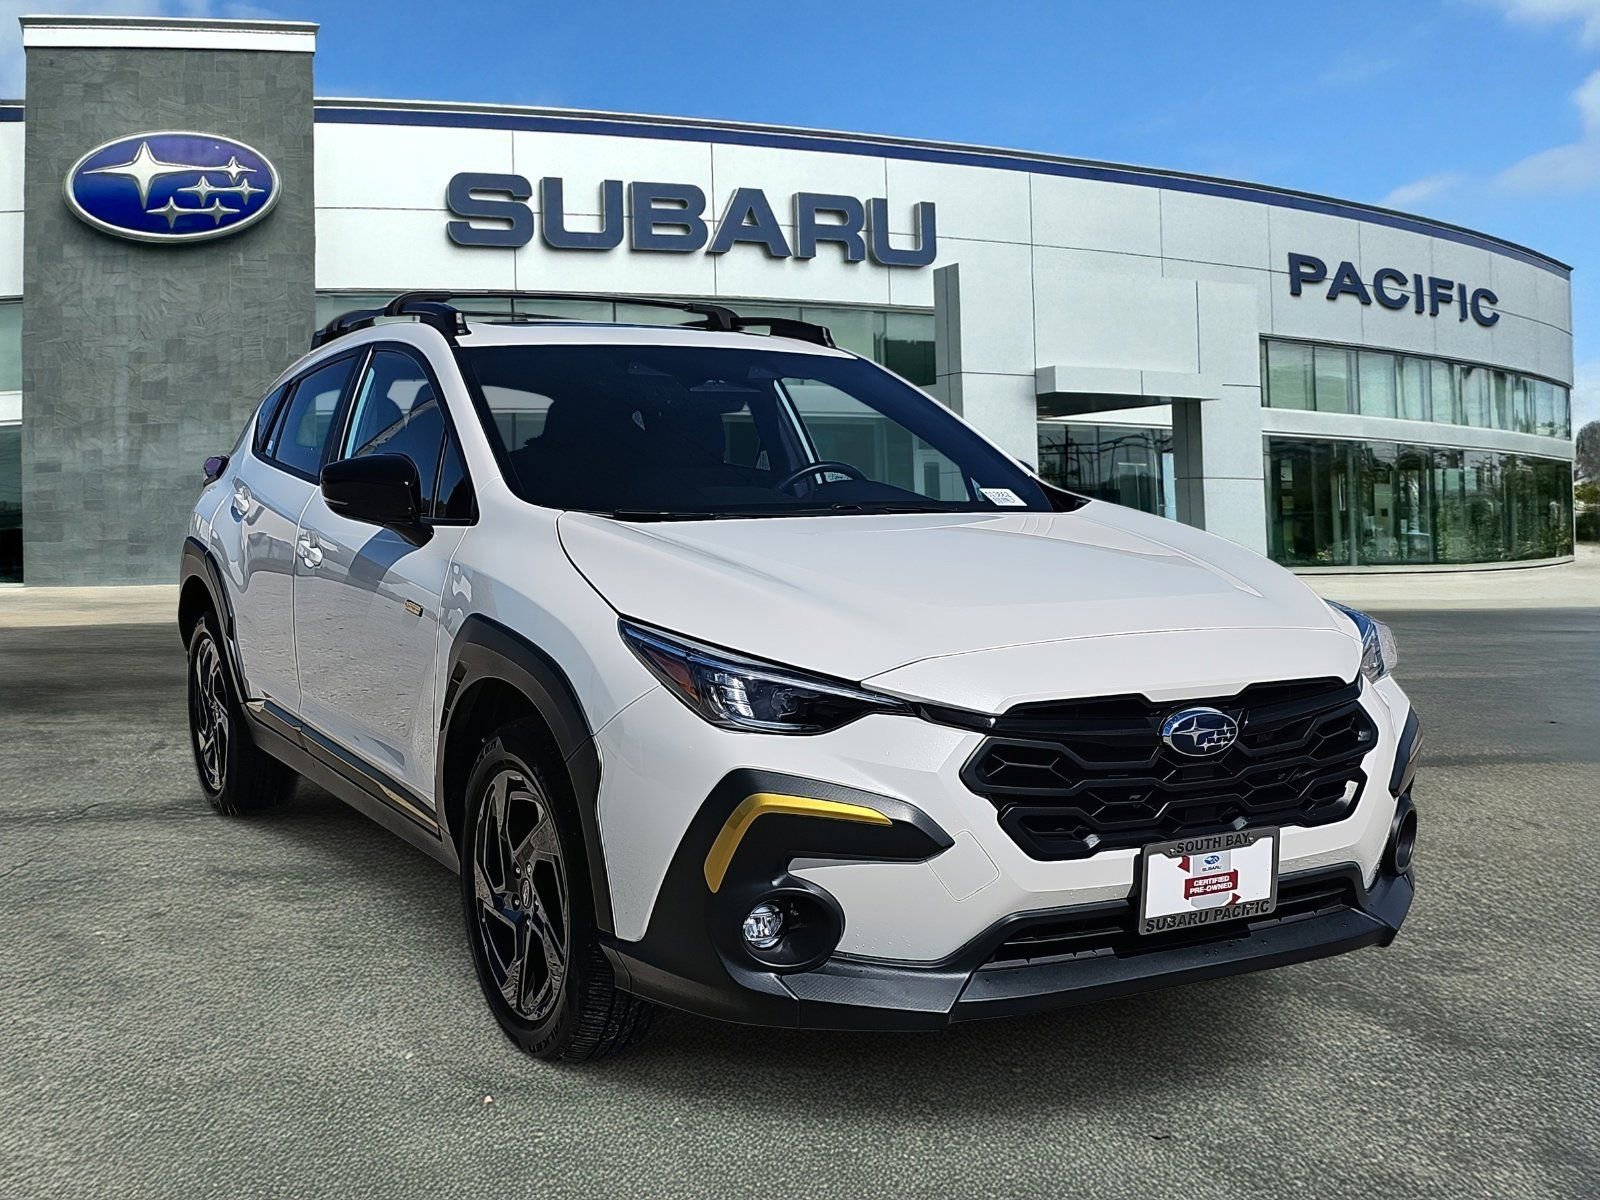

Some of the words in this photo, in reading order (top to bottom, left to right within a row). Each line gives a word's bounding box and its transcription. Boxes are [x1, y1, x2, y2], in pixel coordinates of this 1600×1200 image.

[447, 172, 936, 268] SUBARU
[1288, 252, 1500, 327] PACIFIC
[1176, 837, 1221, 854] SOUTH
[1225, 832, 1251, 846] BAY
[1189, 881, 1233, 895] PRE-OWNED
[1193, 875, 1230, 887] CERTIFIED
[1145, 911, 1210, 933] SUBARU
[1213, 900, 1270, 921] PACIFIC
